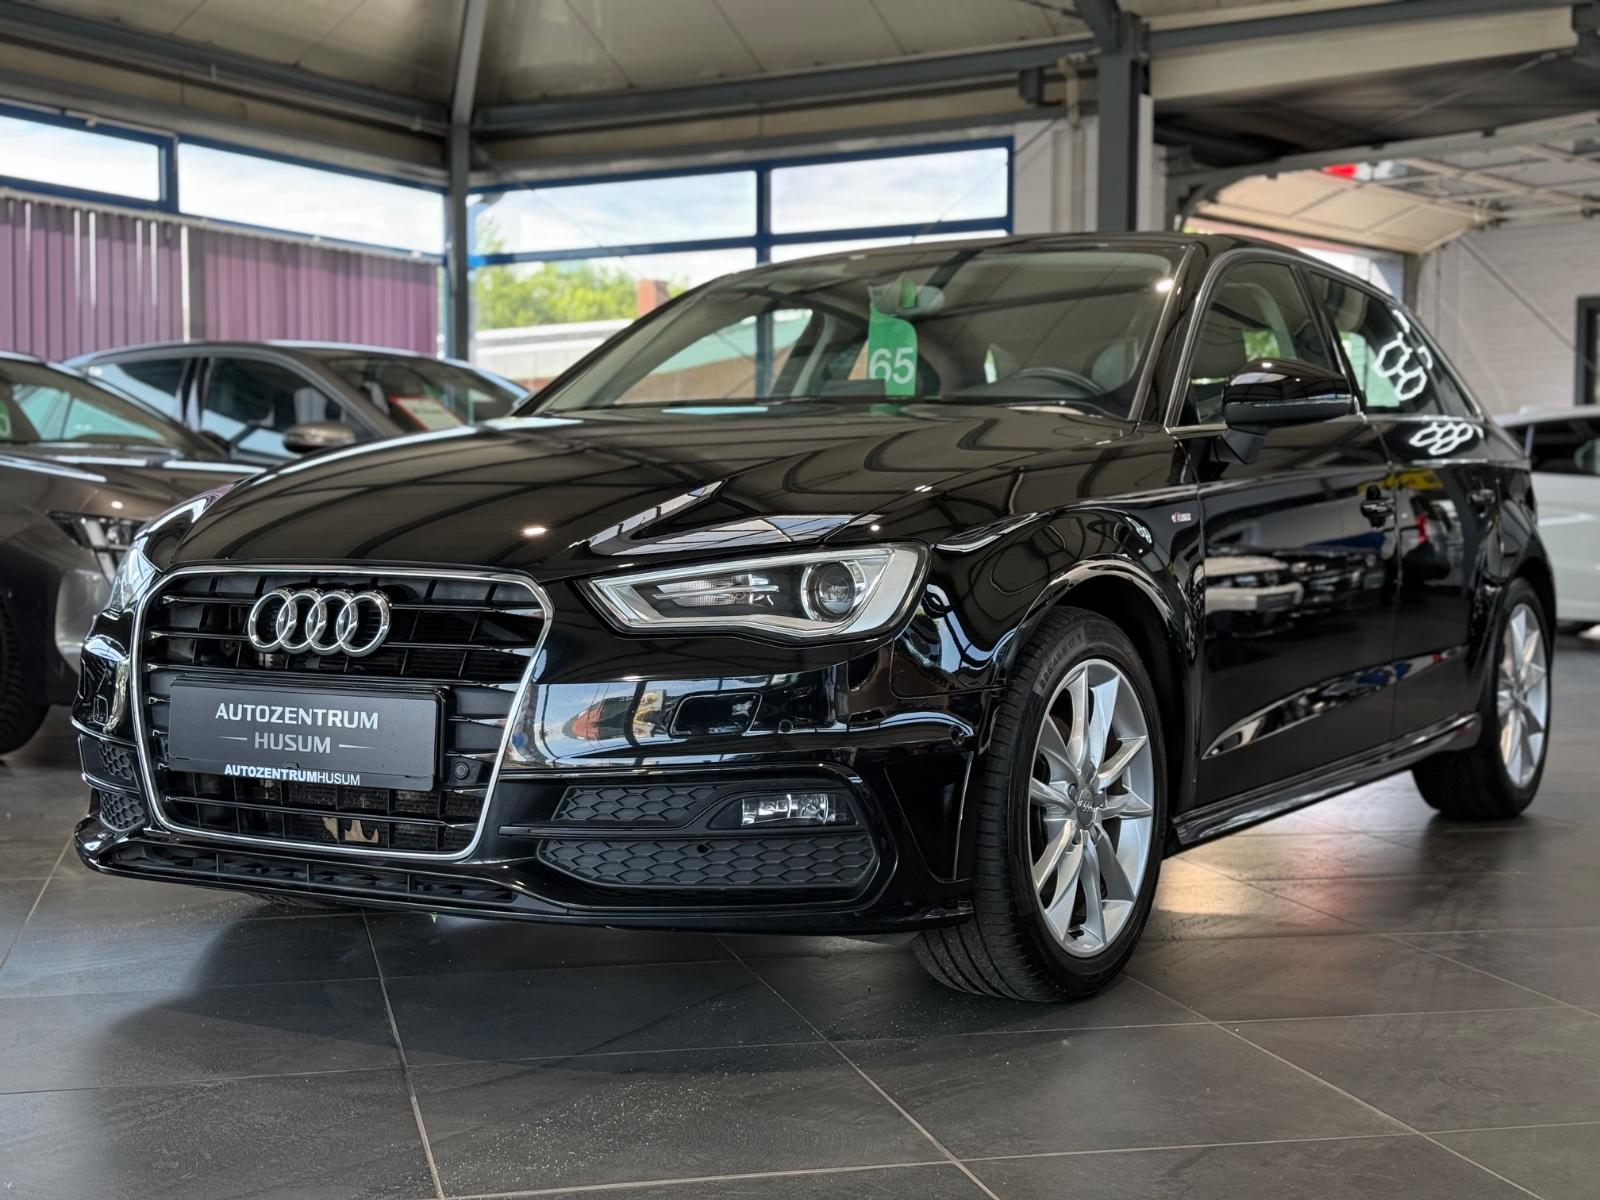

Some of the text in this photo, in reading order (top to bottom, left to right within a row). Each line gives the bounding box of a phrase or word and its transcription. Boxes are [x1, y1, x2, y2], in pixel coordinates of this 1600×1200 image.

[869, 347, 914, 384] 65
[215, 702, 379, 730] AUTOZENTRUM
[254, 731, 331, 754] HUSUM
[224, 763, 361, 786] AUTOZENTRUMHUSUM
